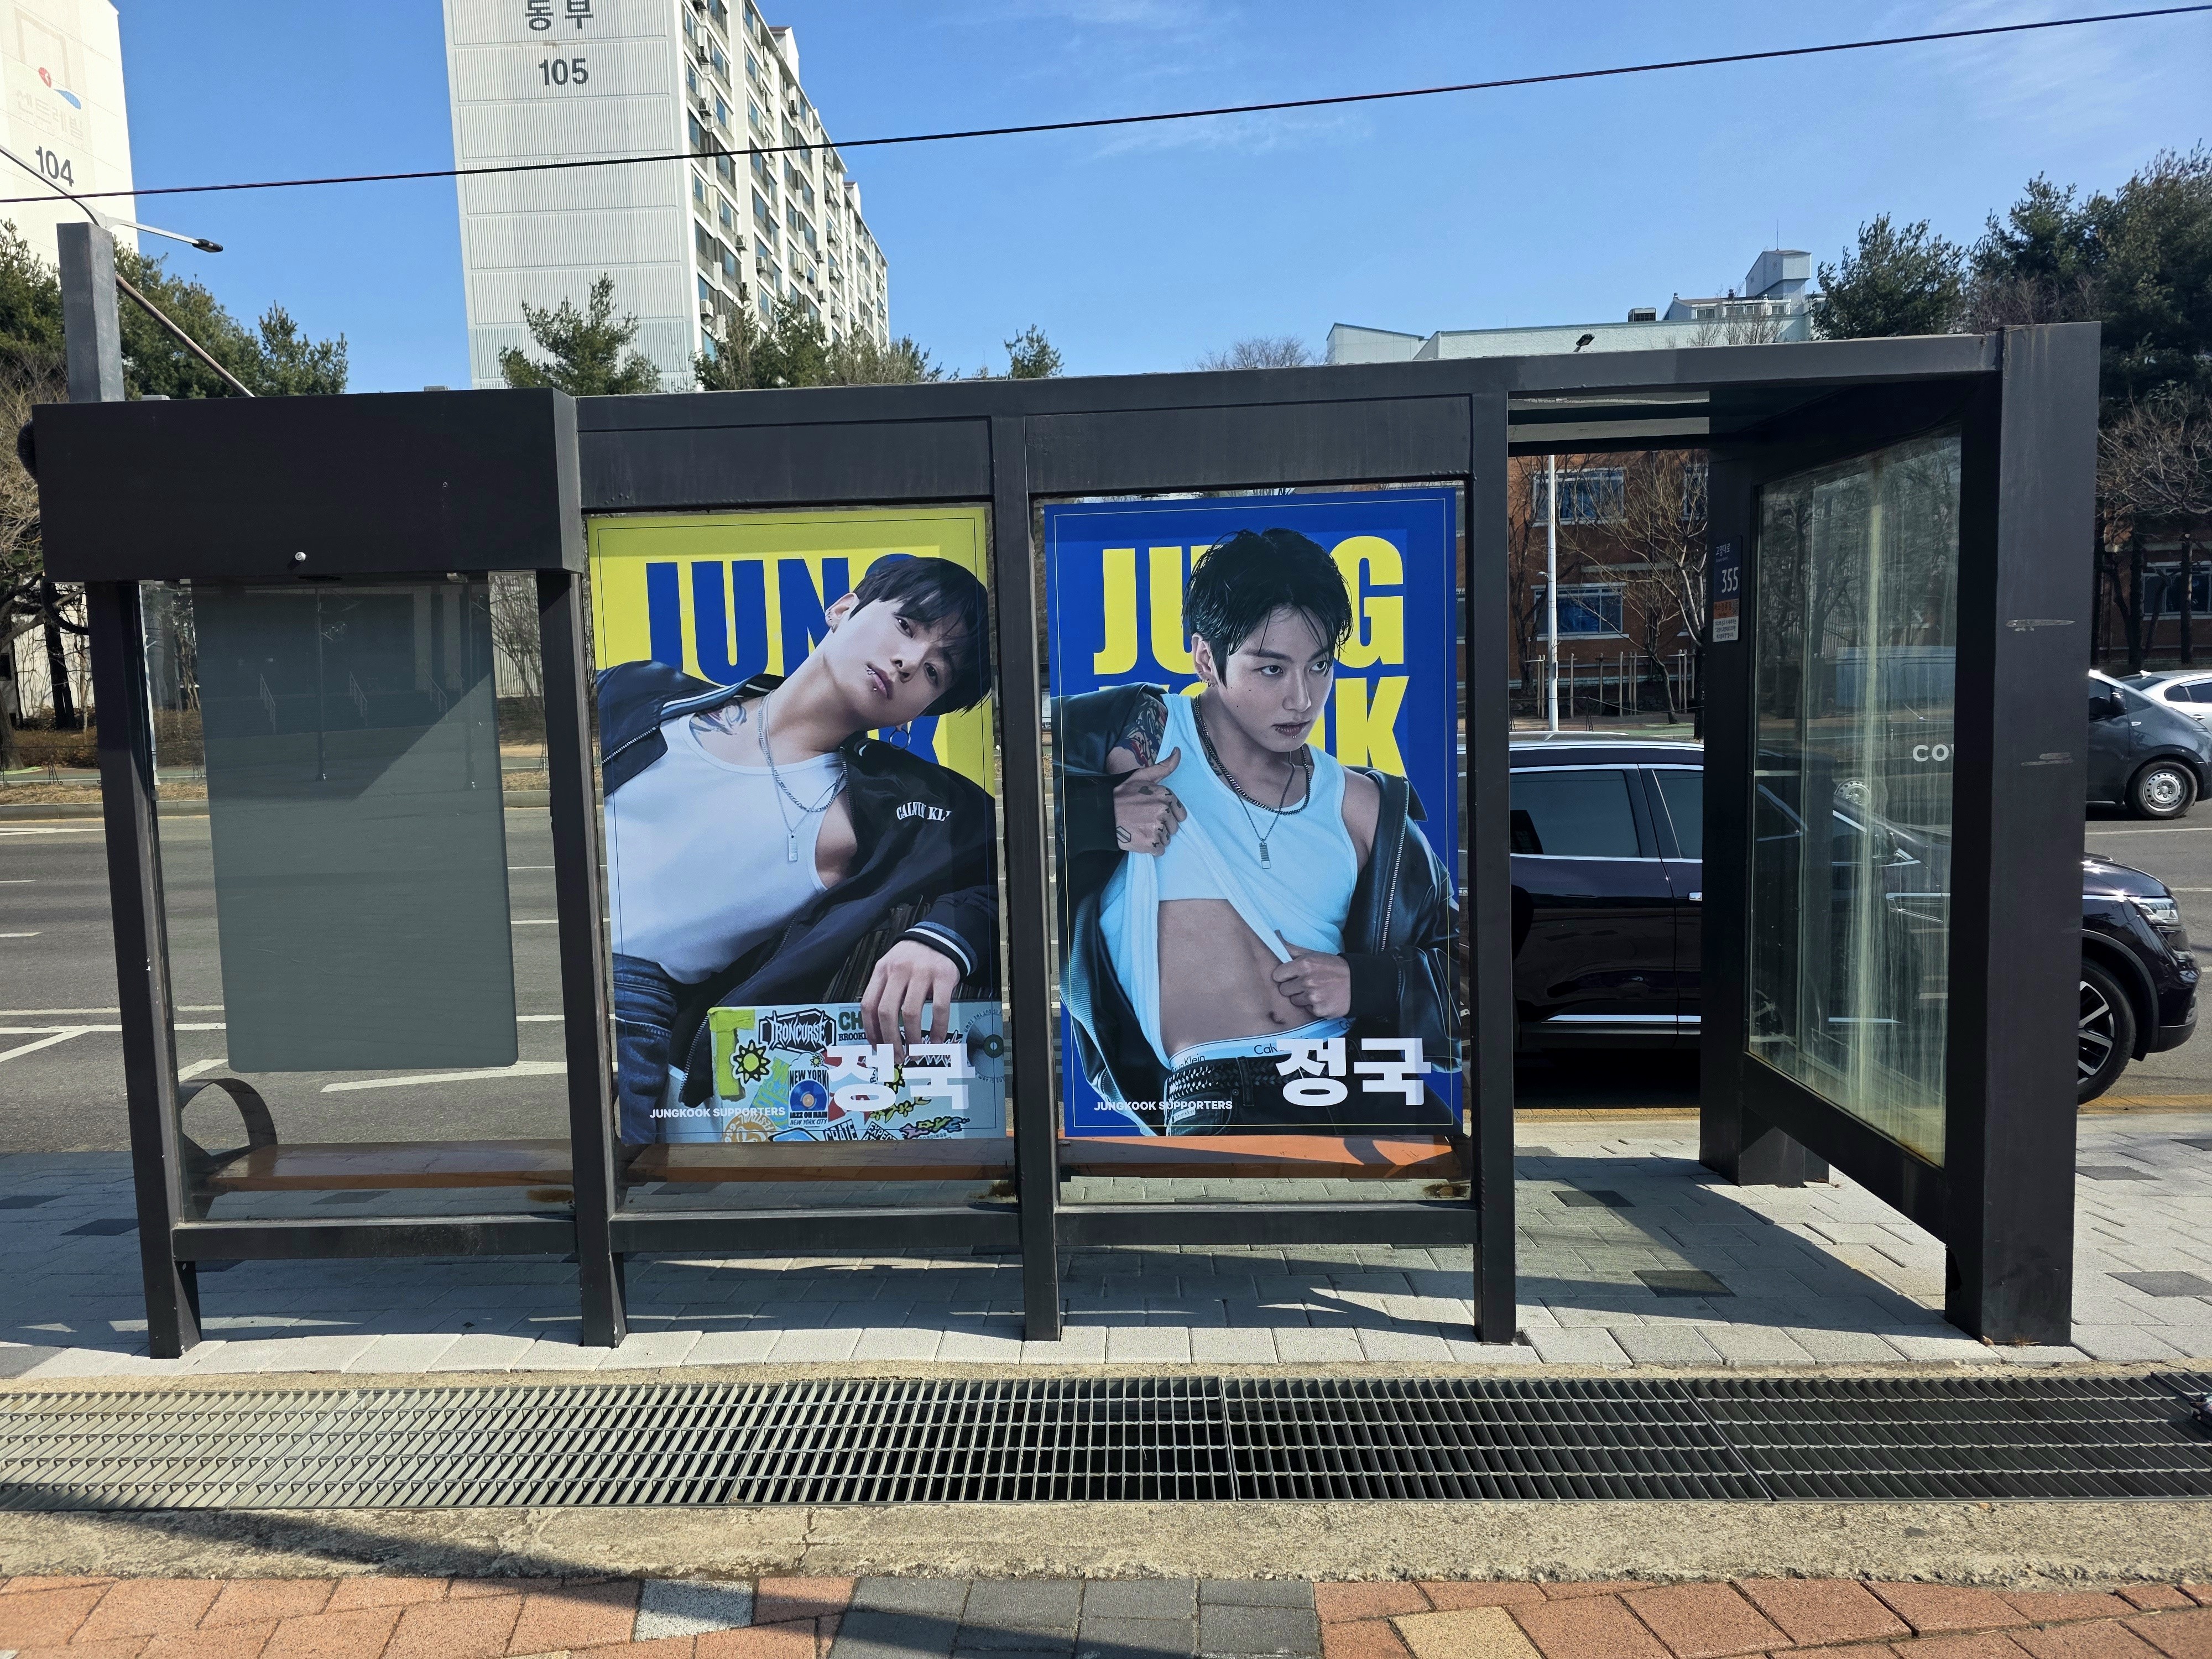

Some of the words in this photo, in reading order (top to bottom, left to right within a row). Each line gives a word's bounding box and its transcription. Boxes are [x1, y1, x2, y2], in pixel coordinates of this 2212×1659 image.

[538, 58, 588, 86] 105
[35, 145, 74, 187] 104
[1721, 566, 1739, 593] 355
[1913, 744, 1954, 761] CO
[789, 1070, 805, 1091] NEW
[807, 1069, 828, 1091] YORK
[827, 1044, 975, 1112] 정국
[1276, 1037, 1431, 1107] 정국
[650, 1108, 711, 1118] JUNGKOOK
[713, 1107, 785, 1117] SUPPORTERS
[1094, 1101, 1156, 1111] JUNGKOOK
[1159, 1100, 1233, 1110] SUPPORTERS
